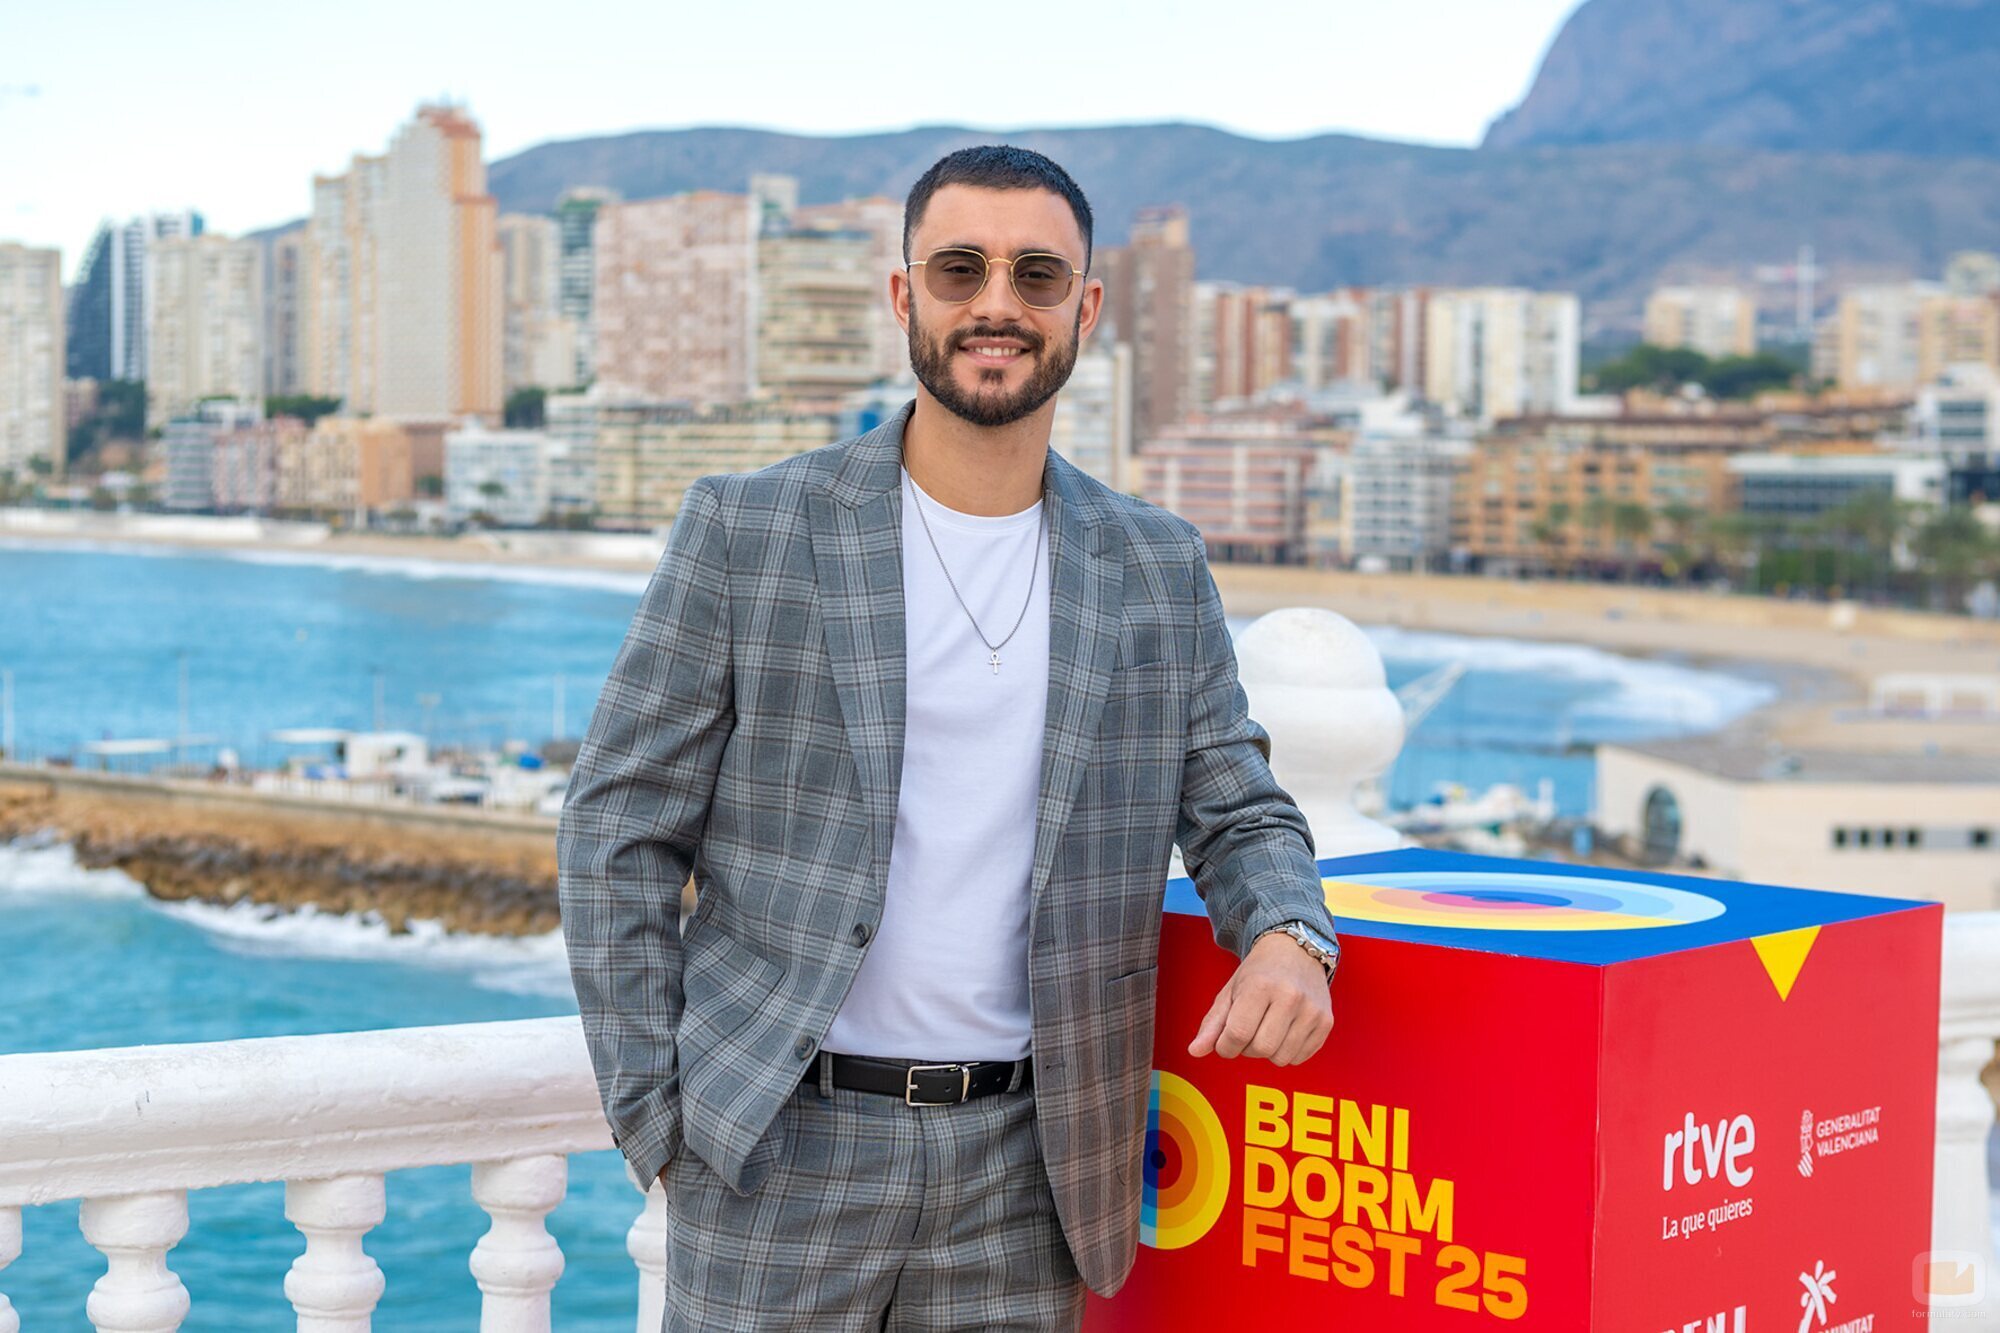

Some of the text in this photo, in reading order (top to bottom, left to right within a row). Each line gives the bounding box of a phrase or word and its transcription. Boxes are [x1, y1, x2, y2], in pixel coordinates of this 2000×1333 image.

[1244, 1083, 1410, 1171] BENI
[1663, 1111, 1756, 1192] rtve
[1816, 1106, 1881, 1138] GENERALITAT
[1816, 1127, 1879, 1157] VALENCIANA
[1243, 1145, 1455, 1243] DORM
[1662, 1196, 1753, 1240] La que quieres
[1242, 1207, 1528, 1320] FEST 25
[1818, 1313, 1875, 1333] NITAT
